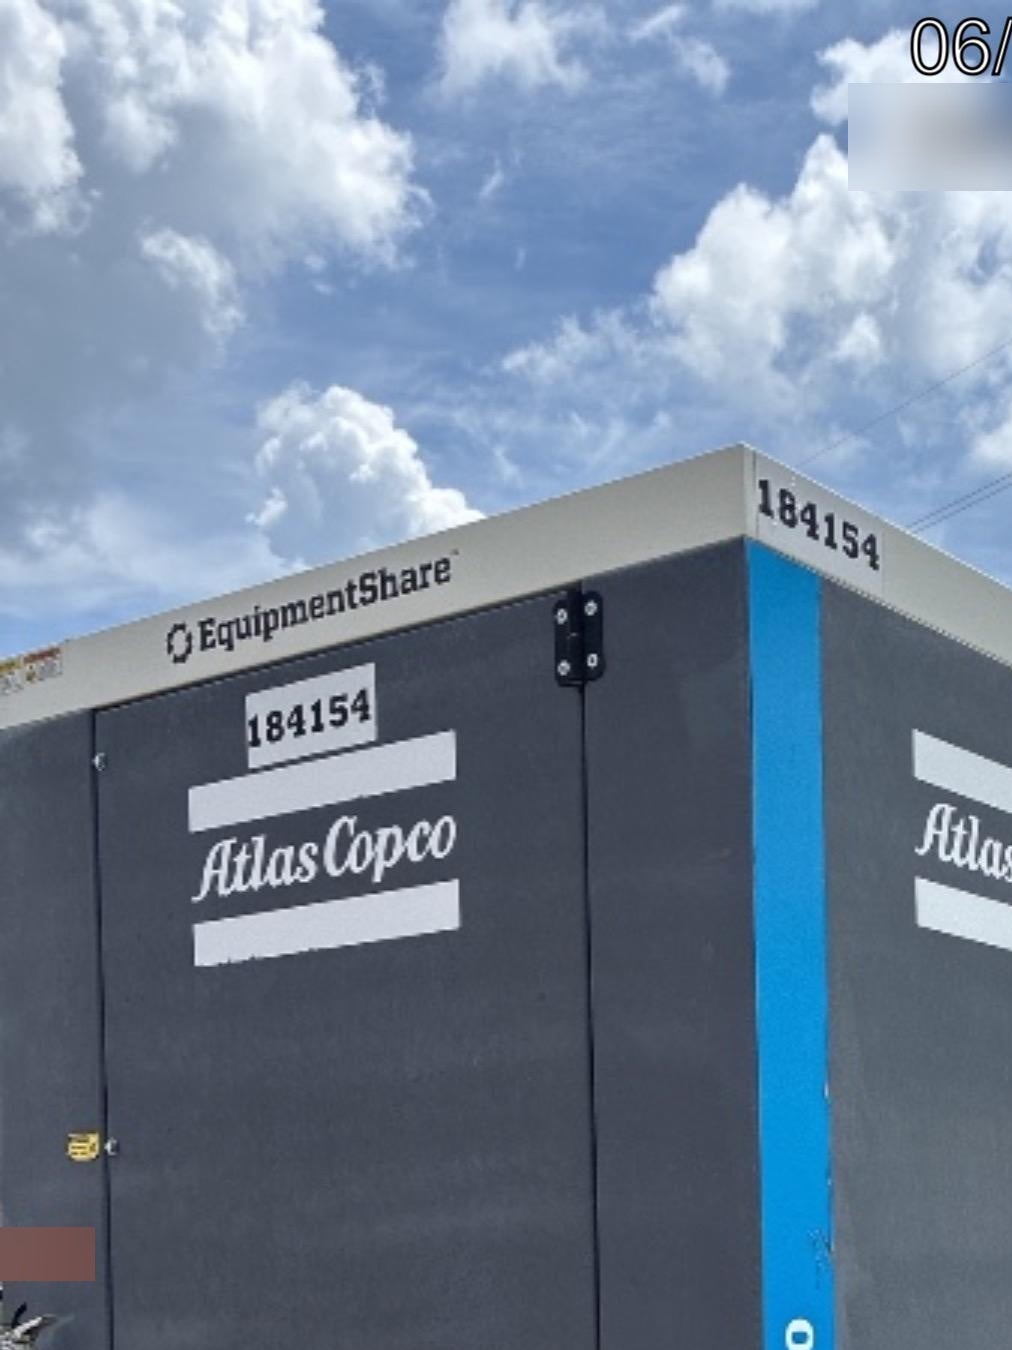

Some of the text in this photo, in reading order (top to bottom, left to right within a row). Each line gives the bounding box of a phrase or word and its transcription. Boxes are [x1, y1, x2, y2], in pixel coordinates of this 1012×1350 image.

[757, 479, 880, 571] 184154
[198, 555, 453, 653] EquipmentShare
[247, 688, 371, 748] 184154
